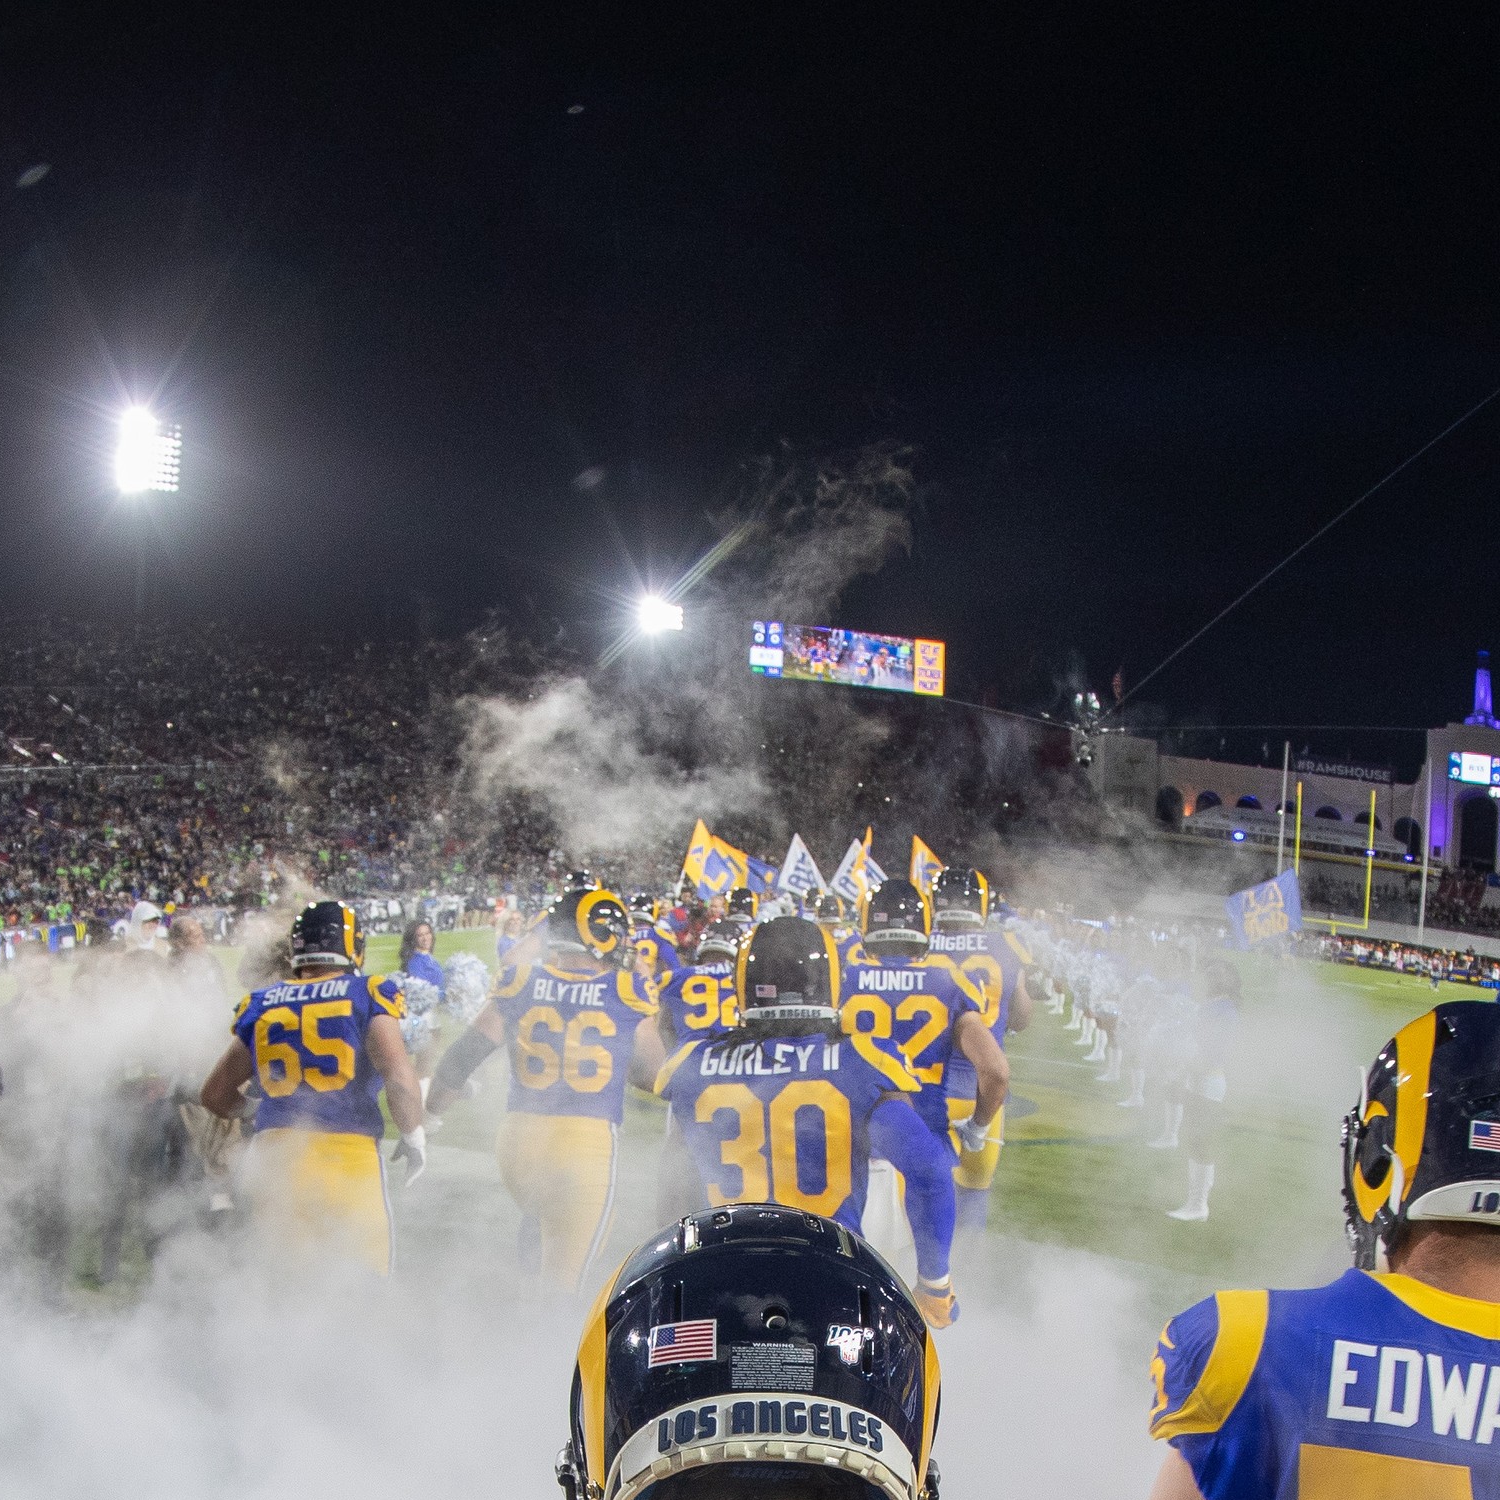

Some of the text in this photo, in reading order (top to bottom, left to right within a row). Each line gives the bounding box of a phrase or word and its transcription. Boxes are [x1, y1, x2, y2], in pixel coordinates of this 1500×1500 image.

[929, 934, 988, 951] HIGBEE
[262, 979, 350, 1007] SHELTON
[533, 978, 608, 1007] BLYTHE
[680, 975, 739, 1031] 92
[858, 970, 927, 991] MUNDT
[254, 999, 356, 1099] 65
[516, 1006, 617, 1094] 66
[700, 1043, 815, 1077] GURLEY
[841, 994, 949, 1085] 82
[694, 1080, 852, 1218] 30
[657, 1399, 884, 1453] LOS ANGELES
